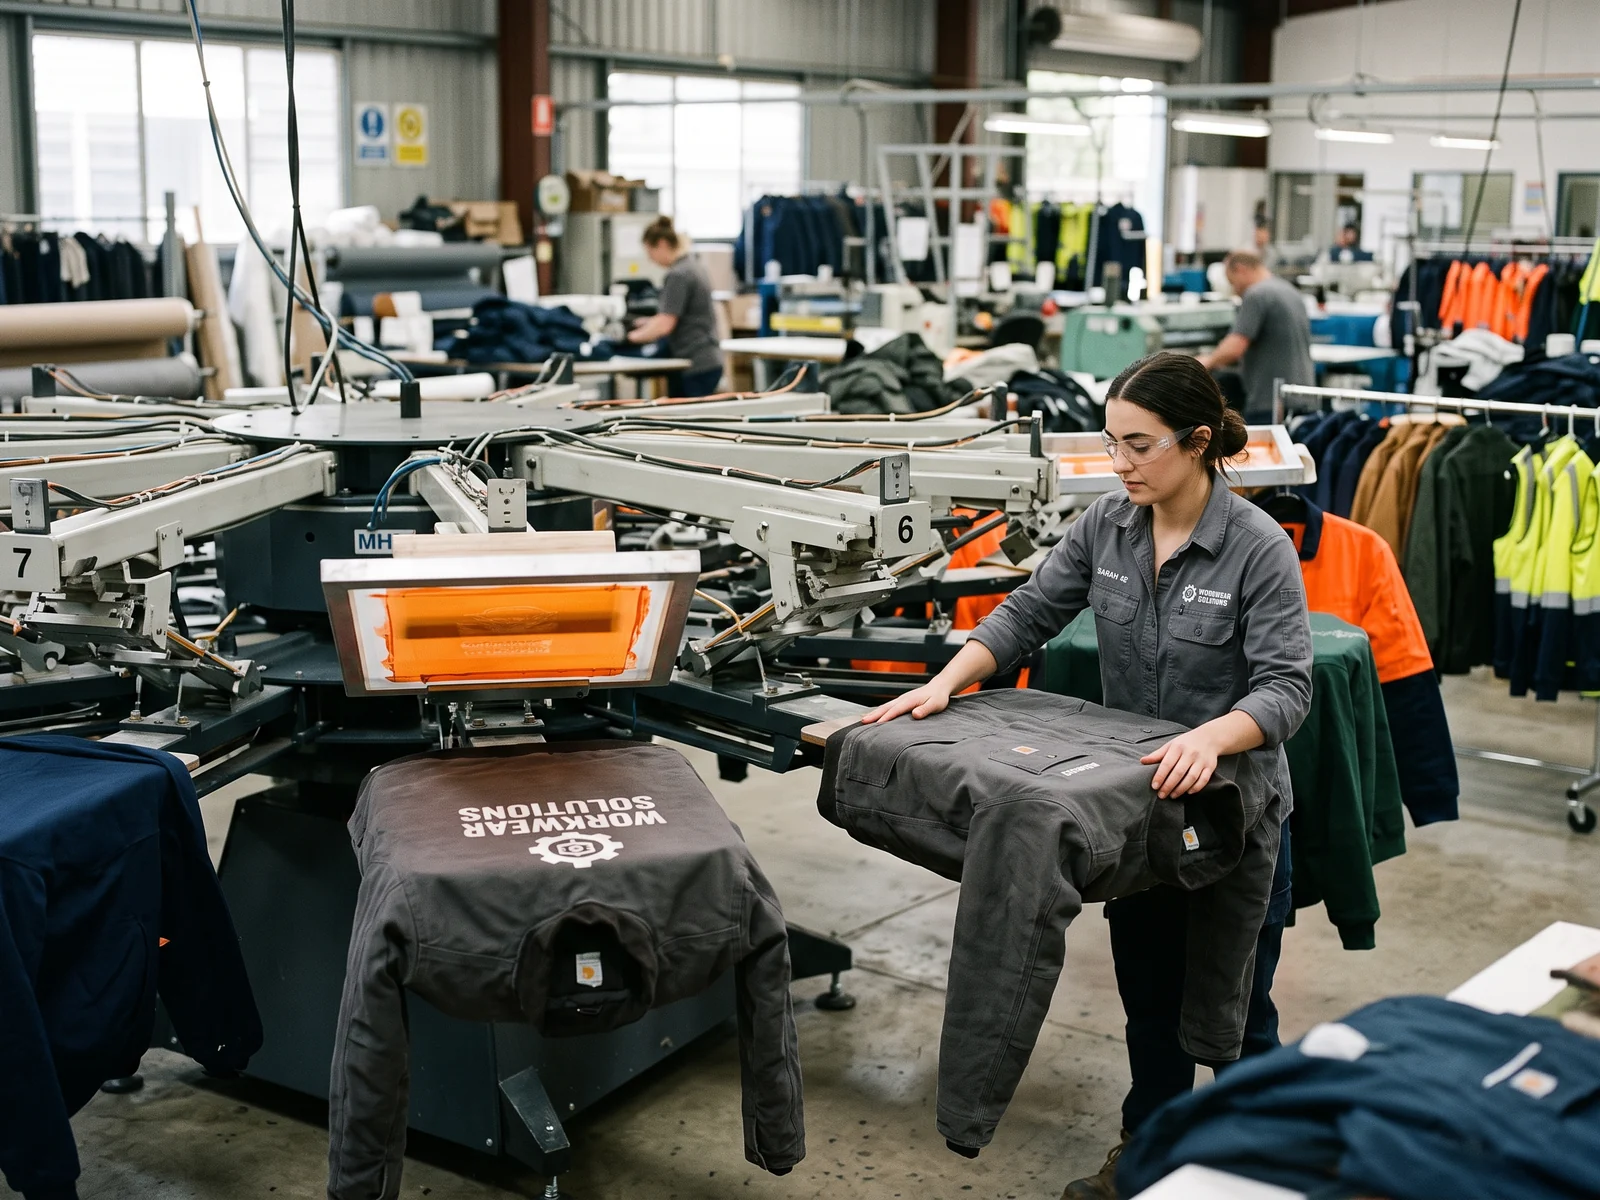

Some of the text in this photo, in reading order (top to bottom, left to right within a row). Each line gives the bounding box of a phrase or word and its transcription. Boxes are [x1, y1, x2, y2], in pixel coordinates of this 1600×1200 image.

[358, 533, 392, 550] MH
[898, 515, 914, 544] 6
[13, 547, 32, 578] 7
[458, 795, 656, 822] SOLUTIONS
[461, 811, 667, 838] WORKWEAR
